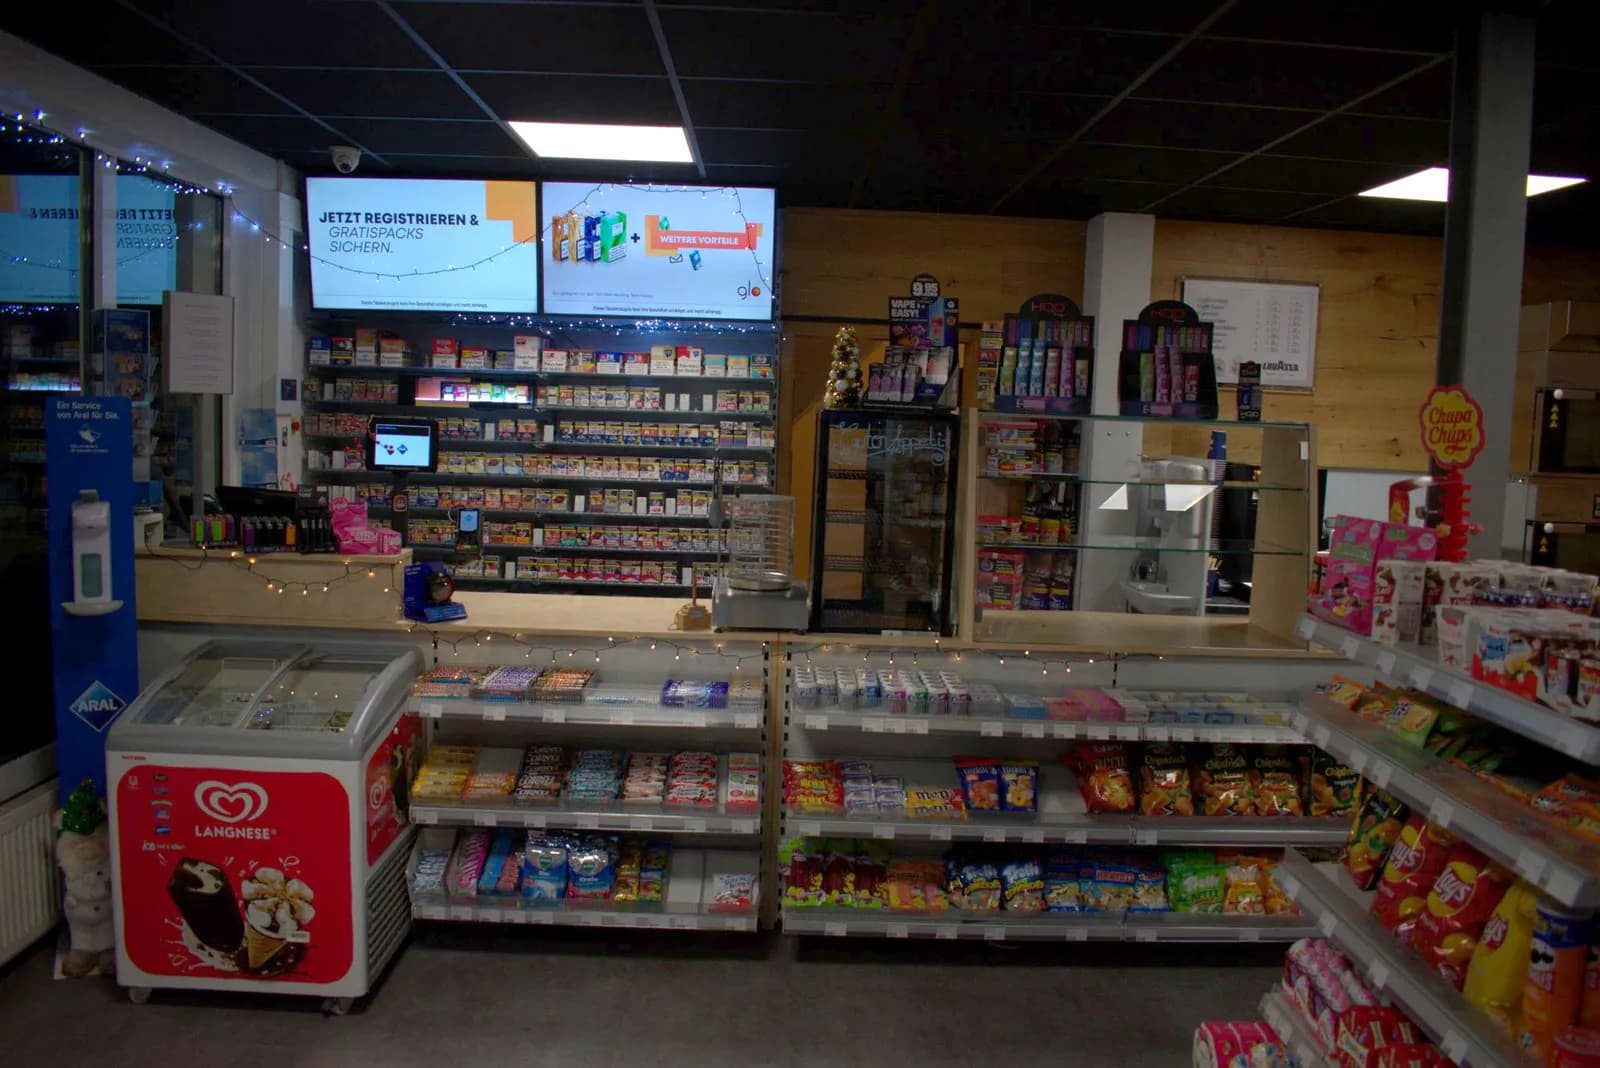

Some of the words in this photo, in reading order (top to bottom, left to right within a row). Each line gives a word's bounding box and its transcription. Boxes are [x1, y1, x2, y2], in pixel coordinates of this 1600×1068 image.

[319, 211, 361, 224] JETZT
[365, 212, 467, 226] REGISTRIEREN
[470, 214, 480, 225] &
[329, 226, 424, 240] GRATISPACKS
[329, 240, 394, 254] SICHERN.
[659, 235, 697, 245] WEITERE
[698, 236, 739, 246] VORTEILE
[737, 280, 761, 300] glo
[891, 299, 916, 309] VAPE
[891, 308, 920, 318] EASY!
[57, 401, 70, 410] Ein
[72, 401, 102, 410] Service
[56, 412, 72, 420] von
[73, 411, 90, 420] Aral
[91, 411, 103, 420] für
[1429, 407, 1473, 427] Chupa
[1429, 426, 1473, 445] Chups
[78, 699, 120, 712] ARAL
[194, 825, 272, 841] LANGNESE
